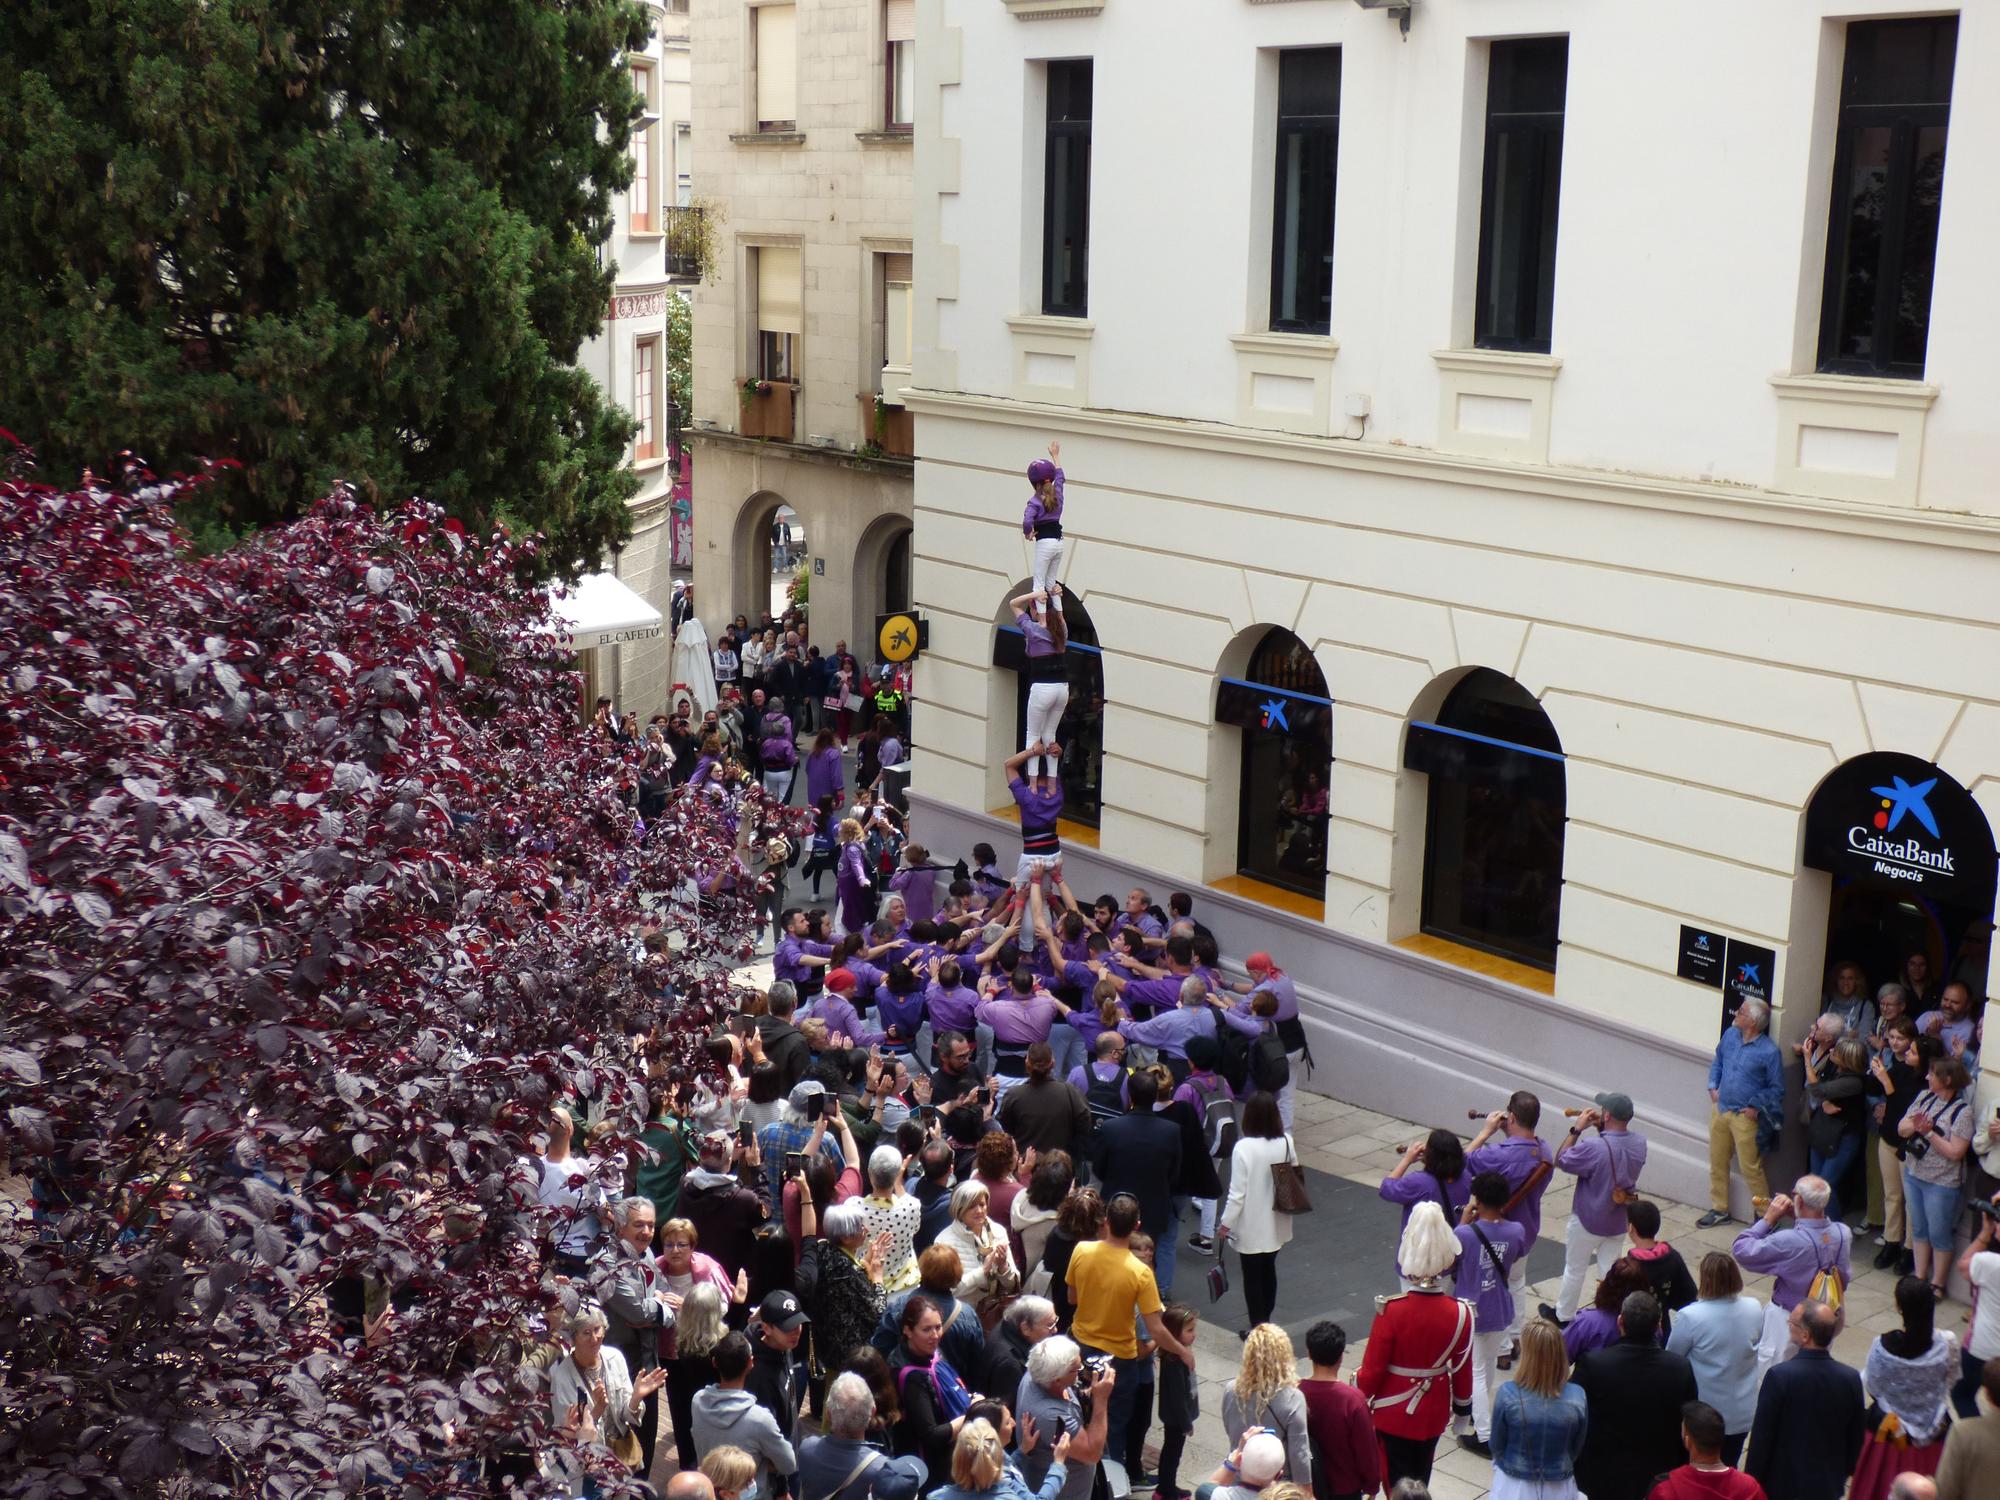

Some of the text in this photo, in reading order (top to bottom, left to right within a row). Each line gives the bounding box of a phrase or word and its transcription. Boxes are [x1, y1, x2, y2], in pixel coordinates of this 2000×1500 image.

[599, 634, 613, 645] EL
[1848, 826, 1955, 871] CaixaBank
[1874, 861, 1924, 882] Negocis
